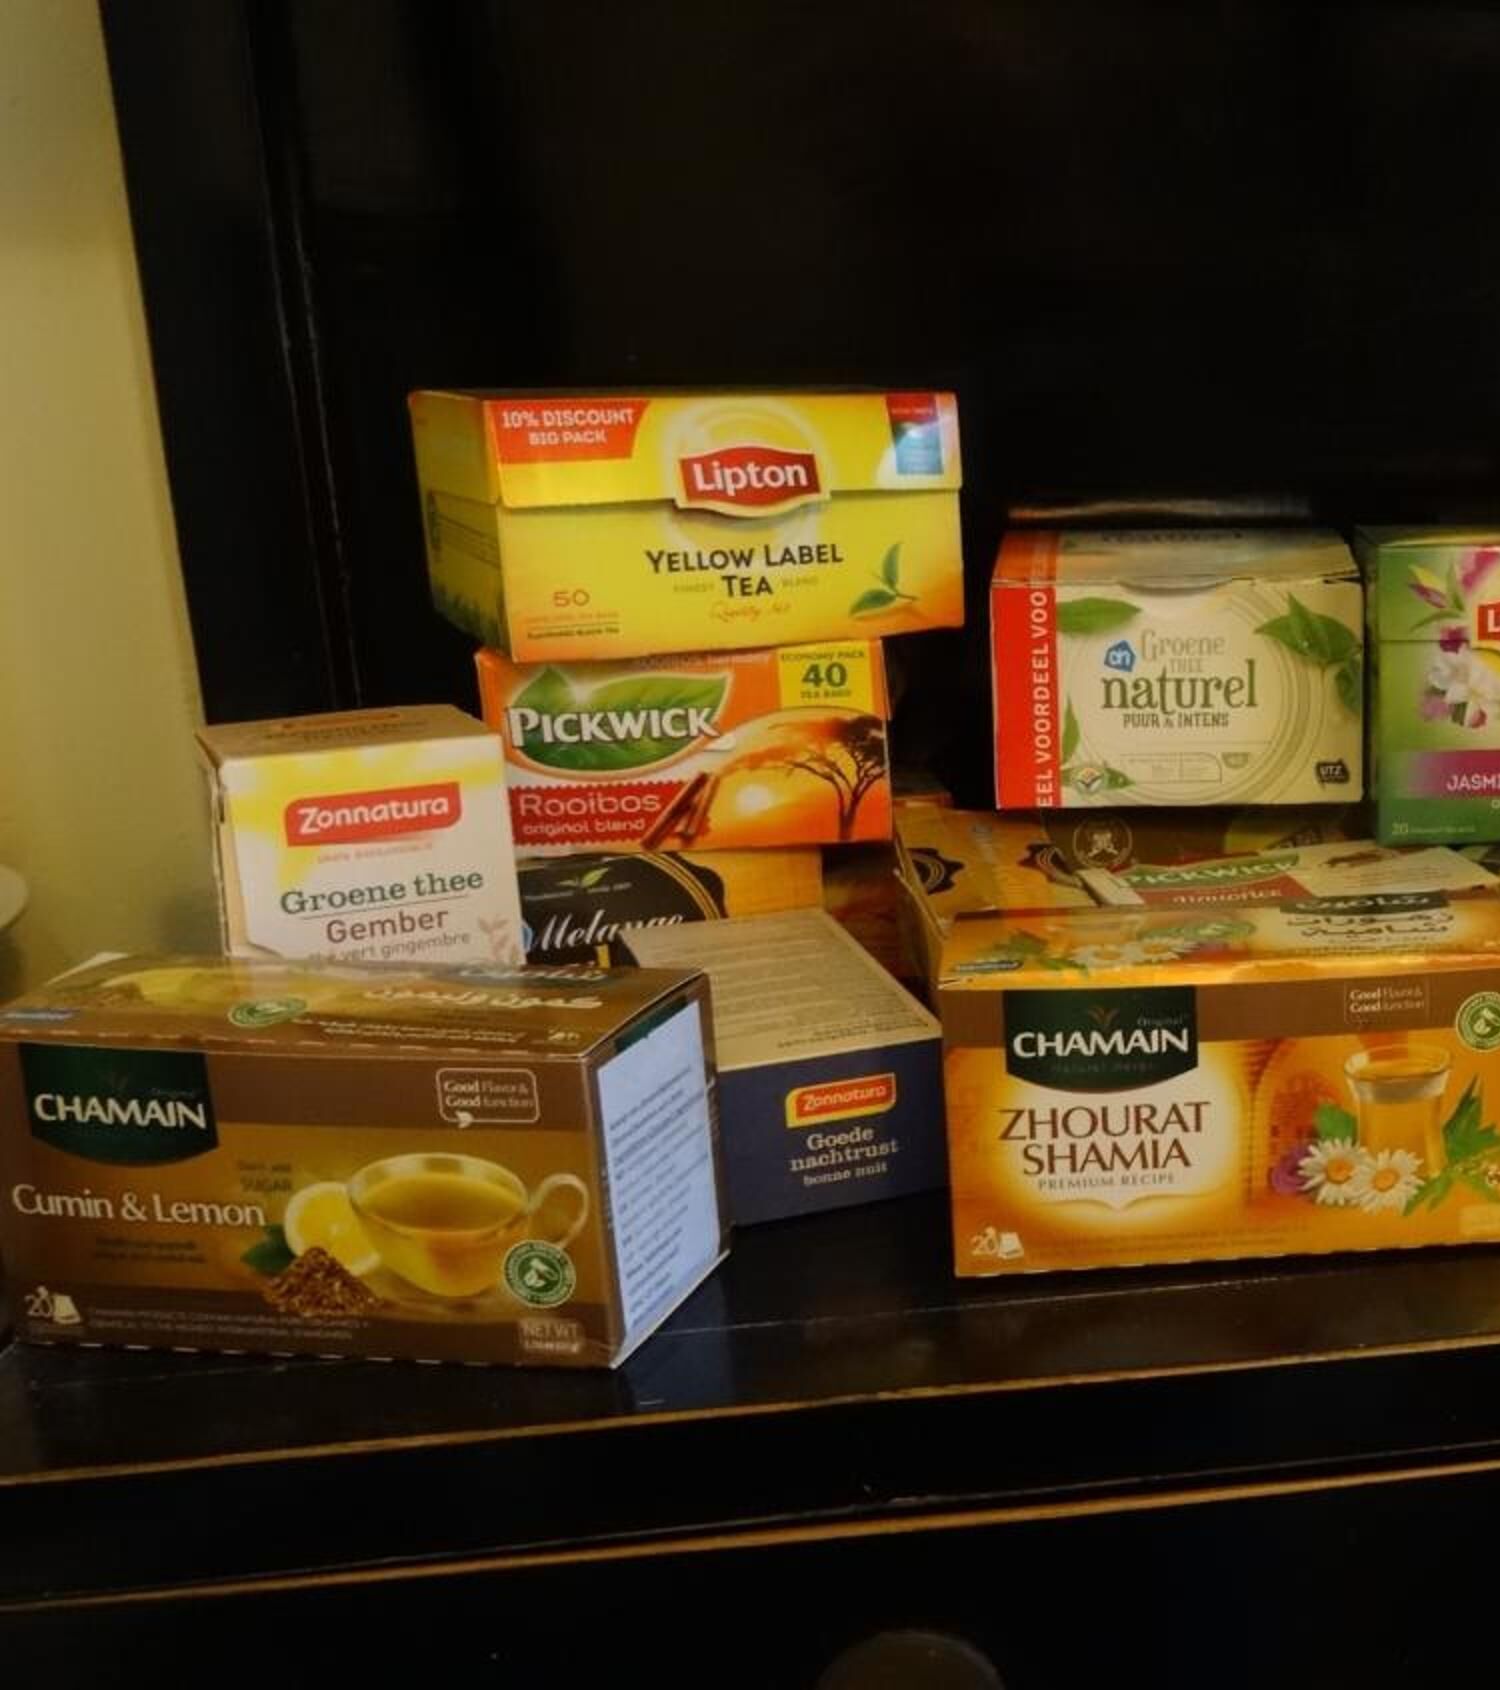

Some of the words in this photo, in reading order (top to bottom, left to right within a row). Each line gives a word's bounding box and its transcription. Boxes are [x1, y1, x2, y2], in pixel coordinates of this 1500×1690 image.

[502, 409, 541, 429] 10%
[542, 408, 636, 427] DISCOUNT
[528, 431, 560, 446] BIG
[562, 429, 608, 444] PACK
[692, 460, 809, 497] Lipton
[645, 548, 755, 574] YELLOW
[764, 543, 845, 567] LABEL
[553, 589, 591, 608] 50
[721, 574, 774, 598] TEA
[1140, 628, 1227, 662] Groene
[801, 662, 848, 688] 40
[1101, 658, 1259, 716] naturel
[1032, 642, 1051, 764] VOORDEEL
[508, 706, 719, 748] PICKWICK
[1122, 713, 1161, 729] PUUR
[1176, 711, 1230, 728] INTENS
[297, 796, 449, 834] Zonnatura
[518, 792, 662, 817] Rooibos
[522, 819, 591, 837] original
[594, 816, 645, 834] blend
[280, 882, 406, 915] Groene
[413, 871, 484, 898] thee
[325, 909, 450, 944] Gember
[382, 931, 472, 959] gingembre
[1012, 1027, 1190, 1059] CHAMAIN
[33, 1092, 207, 1130] CHAMAIN
[802, 1082, 888, 1111] Zonnatura
[997, 1101, 1212, 1141] ZHOURAT
[806, 1126, 875, 1151] Goede
[789, 1138, 900, 1172] nachtrust
[1023, 1138, 1192, 1175] SHAMIA
[1038, 1175, 1114, 1191] PREMIUM
[1120, 1172, 1174, 1187] RECIPE
[11, 1183, 114, 1220] Cumin
[120, 1191, 149, 1222] &
[151, 1193, 266, 1227] Lemon
